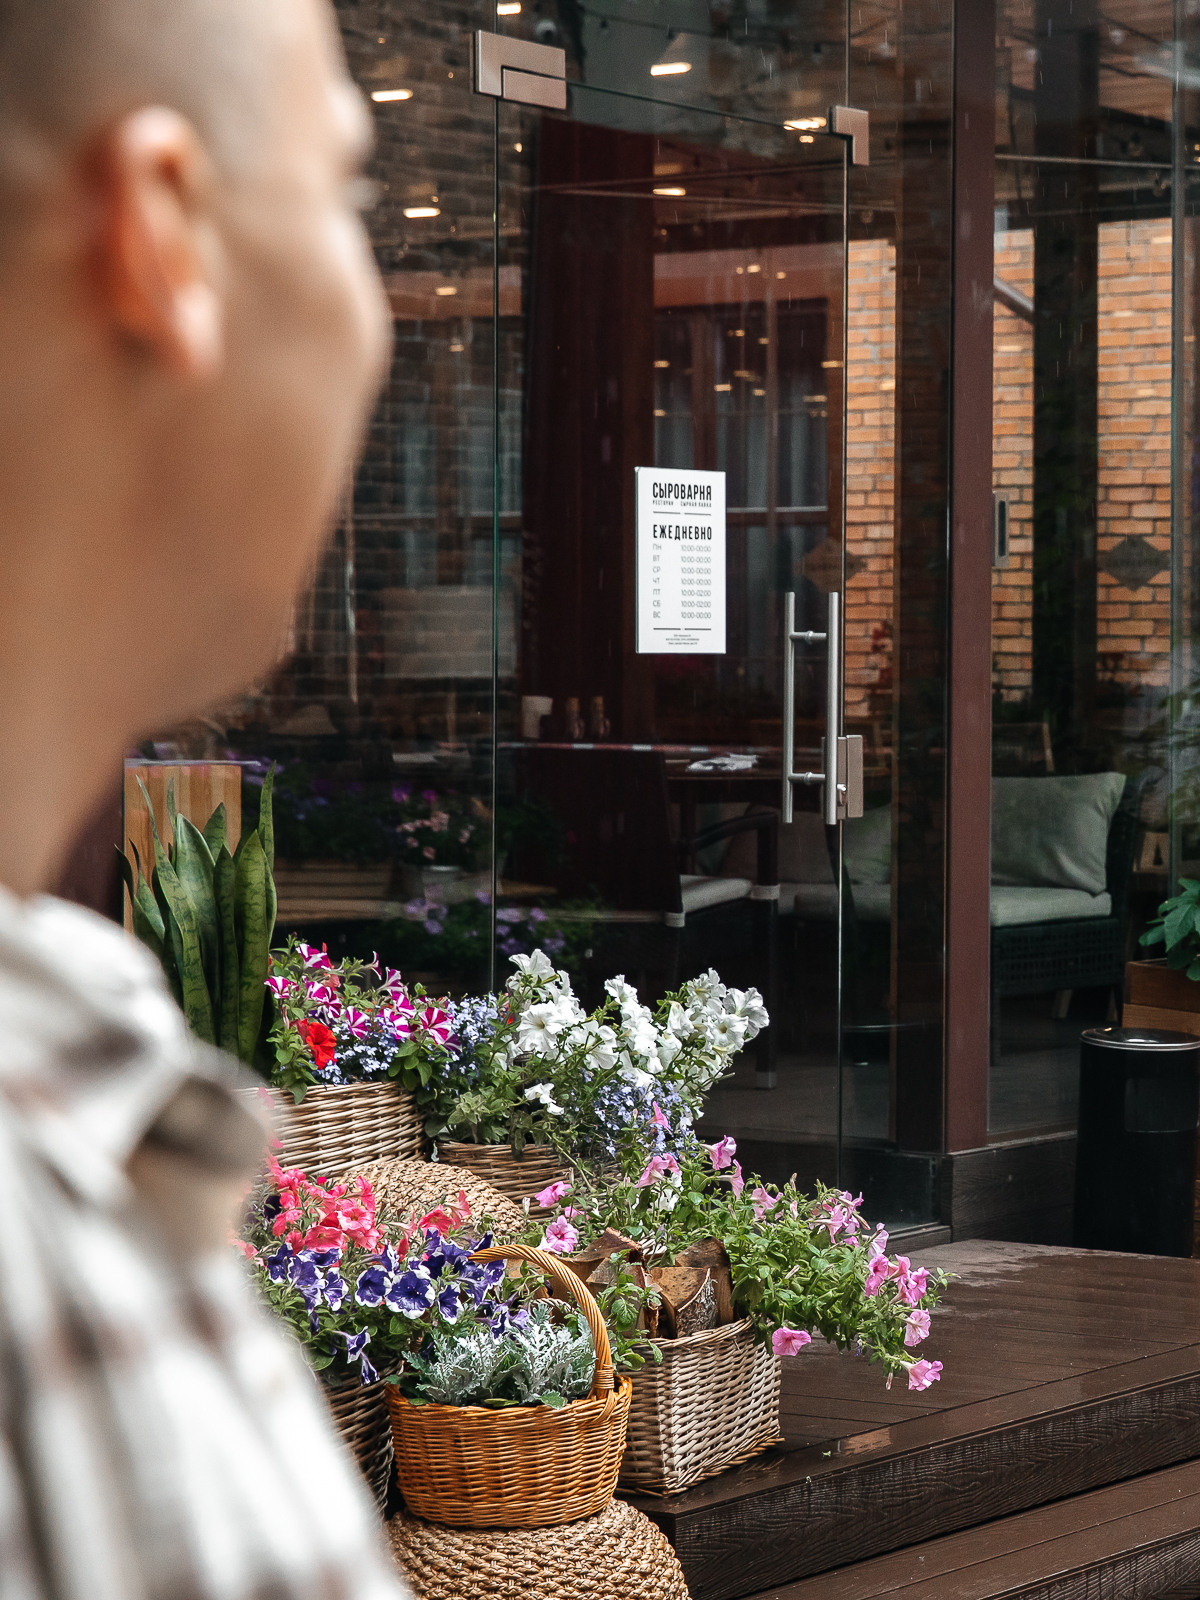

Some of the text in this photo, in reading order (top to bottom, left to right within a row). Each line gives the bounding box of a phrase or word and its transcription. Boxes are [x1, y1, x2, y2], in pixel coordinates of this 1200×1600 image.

[652, 482, 712, 501] СЫРОВАРНЯ
[652, 524, 713, 541] ЕЖЕДНЕВНО
[652, 543, 712, 552] ПН 10:00-00:00
[652, 554, 712, 563] ВТ 10:00-00:00
[680, 578, 712, 586] 10:00-00:00
[652, 588, 712, 597] ПТ 10:00-02:00
[652, 599, 712, 608] СБ 10:00-02:00
[652, 610, 712, 619] ВС 10:00-00:00
